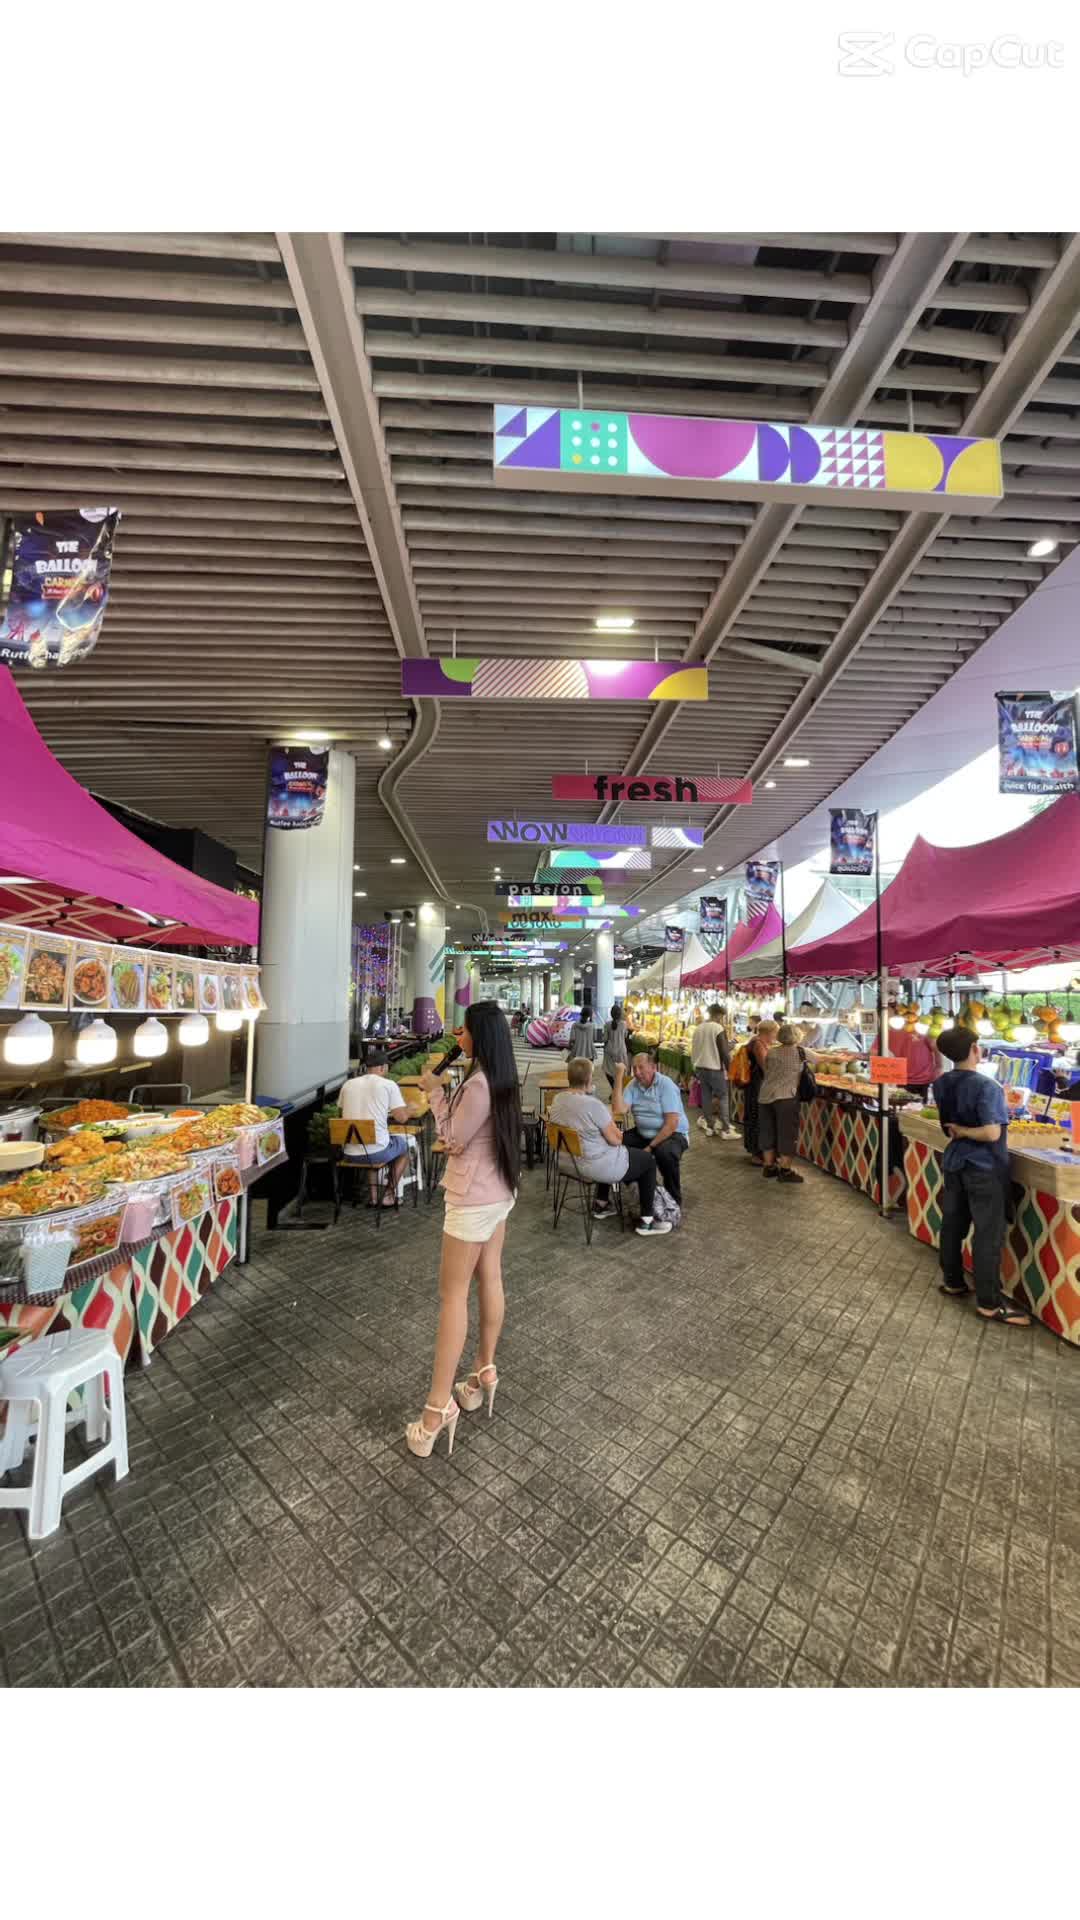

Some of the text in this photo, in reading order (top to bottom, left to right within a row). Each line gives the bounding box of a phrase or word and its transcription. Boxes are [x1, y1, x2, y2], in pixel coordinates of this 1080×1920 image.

[35, 559, 98, 575] BALLOON
[1010, 722, 1058, 734] BALLOON
[283, 771, 319, 780] BALLOON
[594, 776, 698, 802] fresh
[1027, 782, 1040, 790] for
[1042, 782, 1075, 791] health
[509, 884, 583, 896] passion
